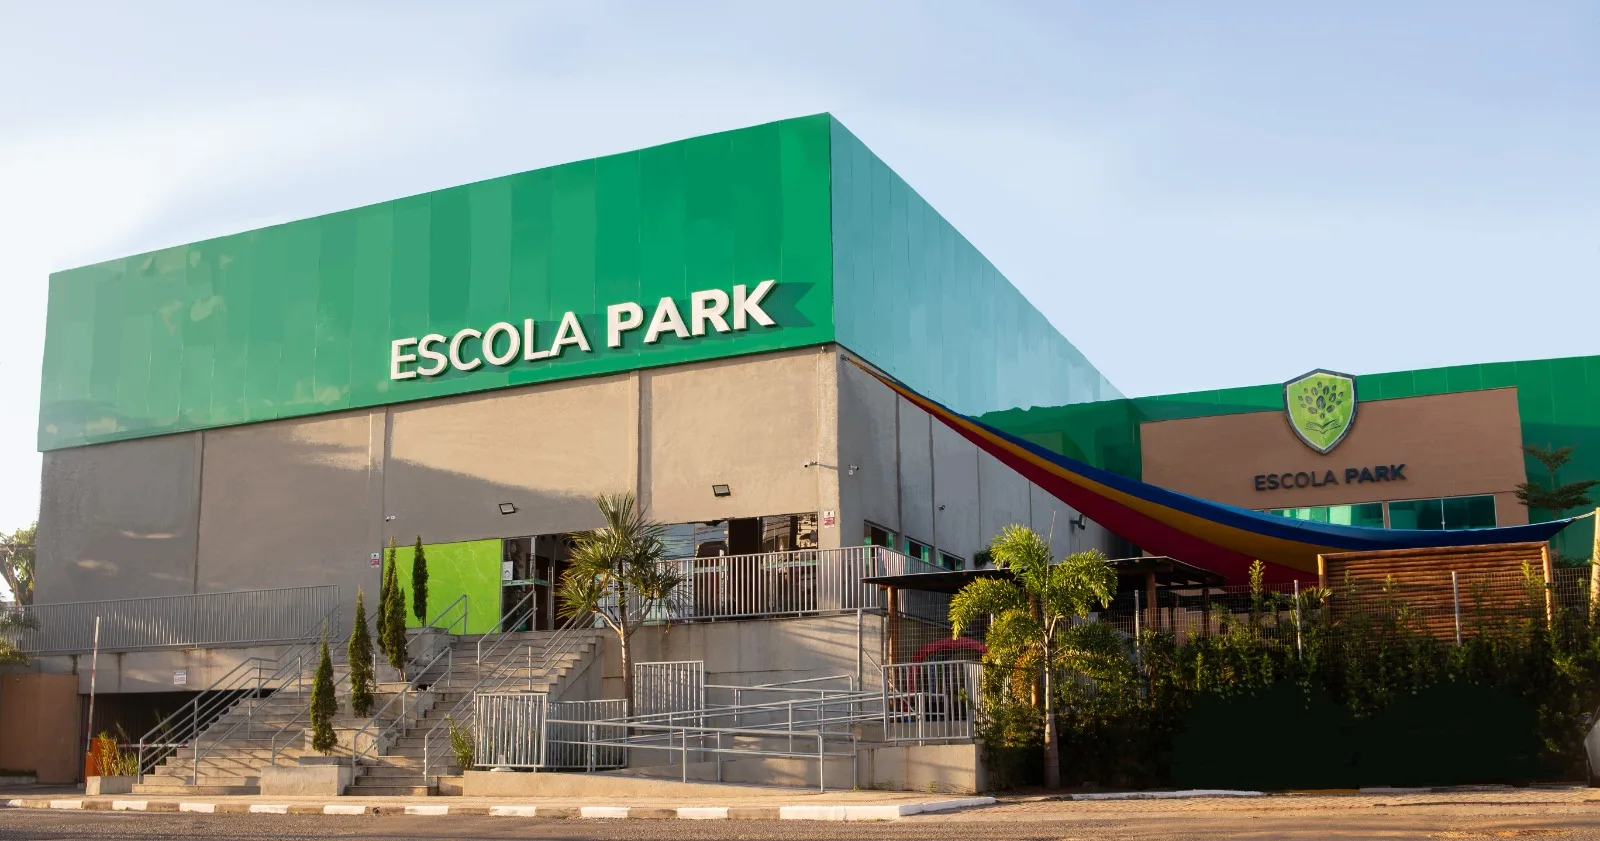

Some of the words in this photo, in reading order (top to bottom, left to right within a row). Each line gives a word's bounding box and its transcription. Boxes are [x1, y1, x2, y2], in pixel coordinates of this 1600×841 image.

[390, 311, 592, 381] ESCOLA
[607, 279, 777, 349] PARK
[1254, 470, 1339, 491] ESCOLA
[1345, 463, 1406, 484] PARK
